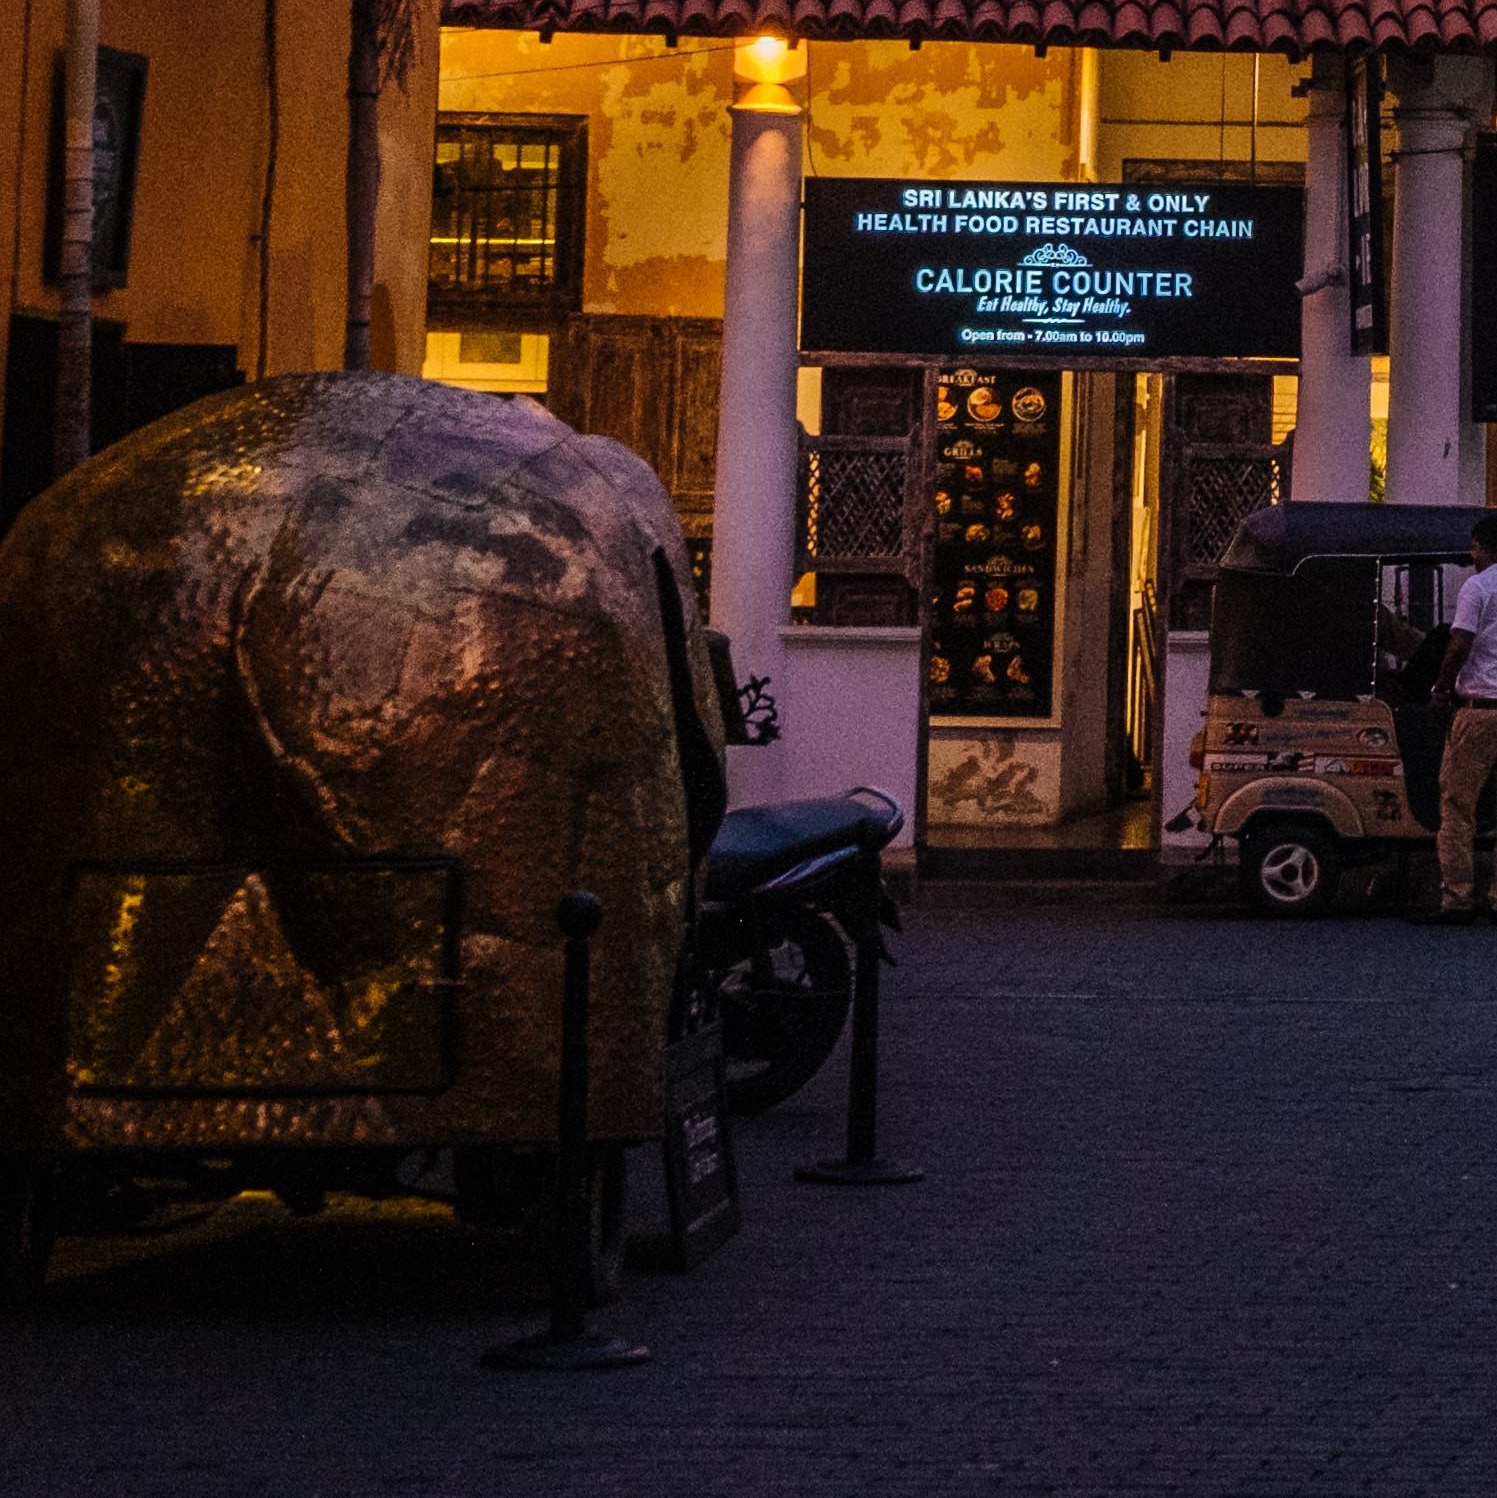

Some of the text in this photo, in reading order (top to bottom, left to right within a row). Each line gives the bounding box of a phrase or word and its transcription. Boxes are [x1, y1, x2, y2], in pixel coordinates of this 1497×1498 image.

[903, 189, 1210, 213] SRI LANKA'S FIRST & ONLY
[857, 213, 1254, 238] HEALTH FOOD RESTAURANT CHAIN
[915, 268, 1193, 297] CALORIE COUNTER
[976, 296, 1132, 318] Eat Healthy, Stay Healthy.
[961, 328, 995, 343] Open
[997, 329, 1026, 341] from
[1035, 330, 1077, 343] 7.00am
[1079, 330, 1093, 342] to
[1095, 331, 1145, 345] 10.00pm
